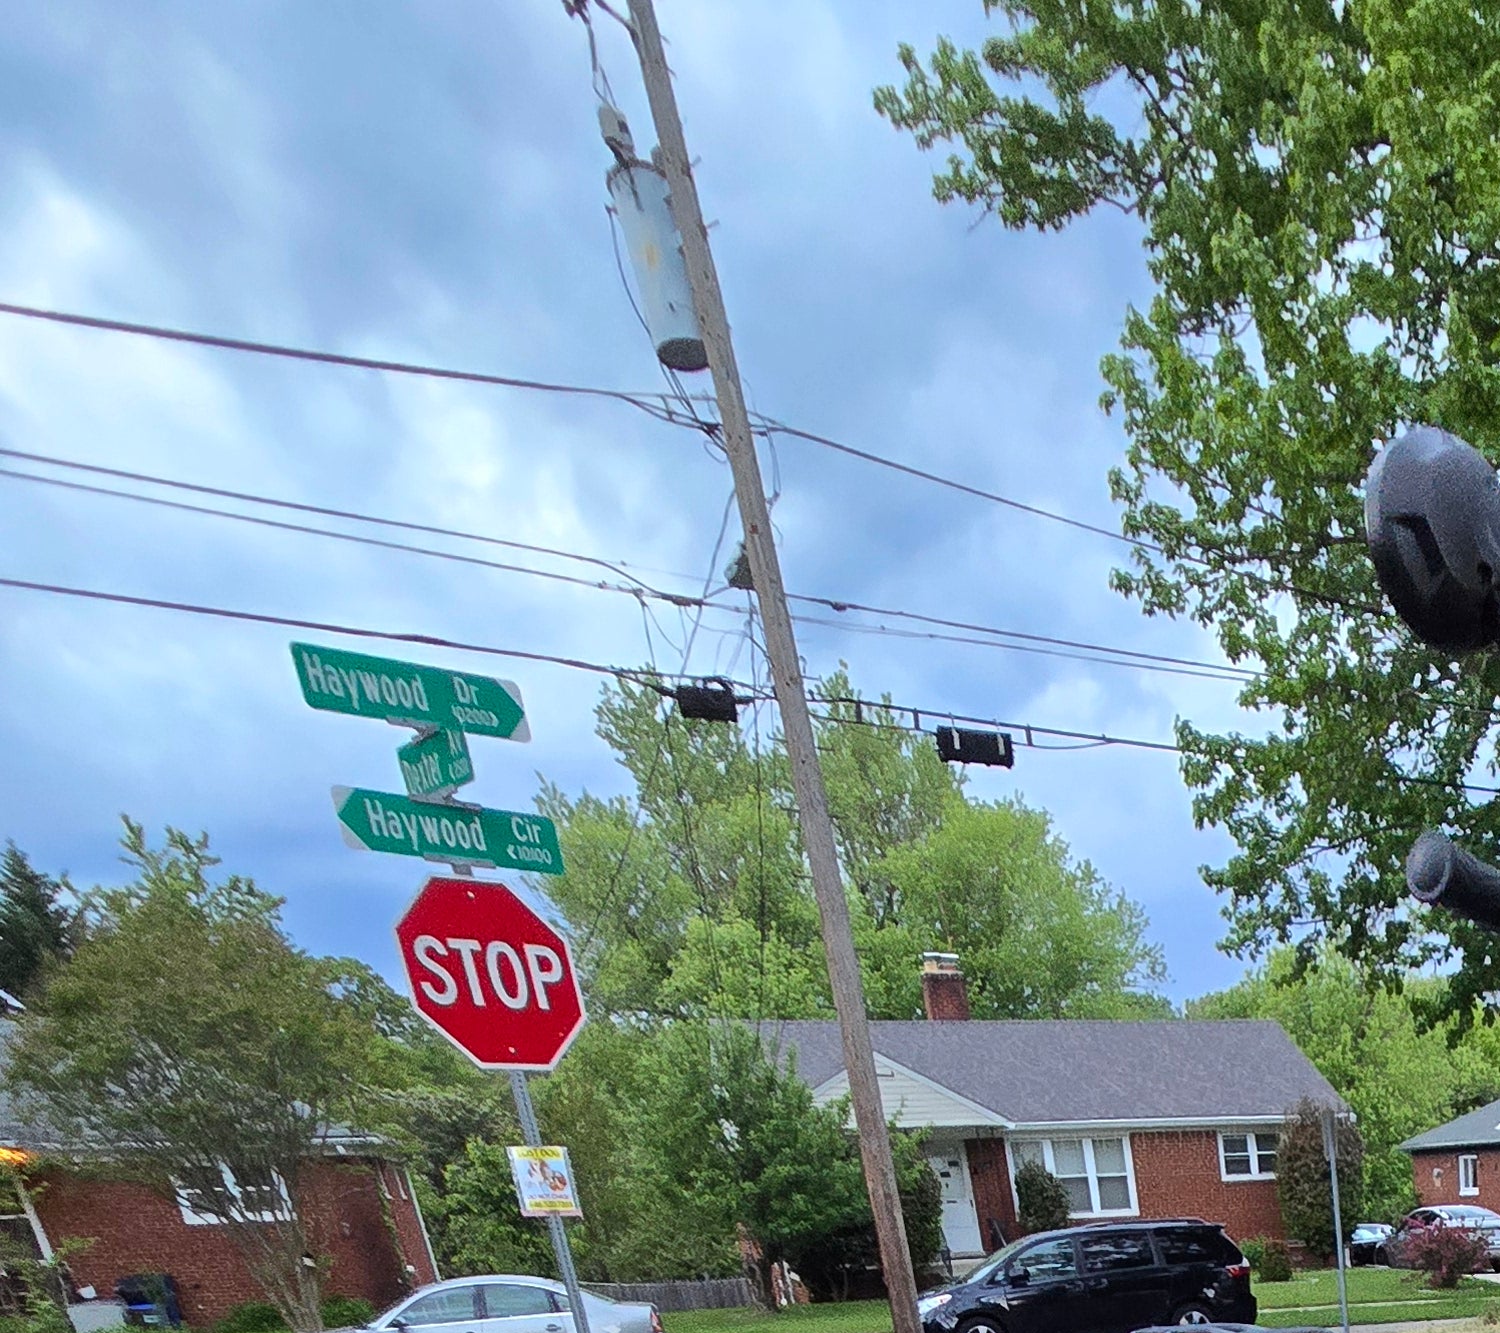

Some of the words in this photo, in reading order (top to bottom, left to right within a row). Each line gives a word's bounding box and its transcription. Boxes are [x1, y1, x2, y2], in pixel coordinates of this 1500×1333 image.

[301, 650, 430, 711] Haywood
[452, 676, 480, 706] Dr
[401, 751, 443, 795] Dexter
[363, 798, 488, 852] Haywood
[511, 816, 542, 844] Cir
[413, 934, 563, 1010] STOP
